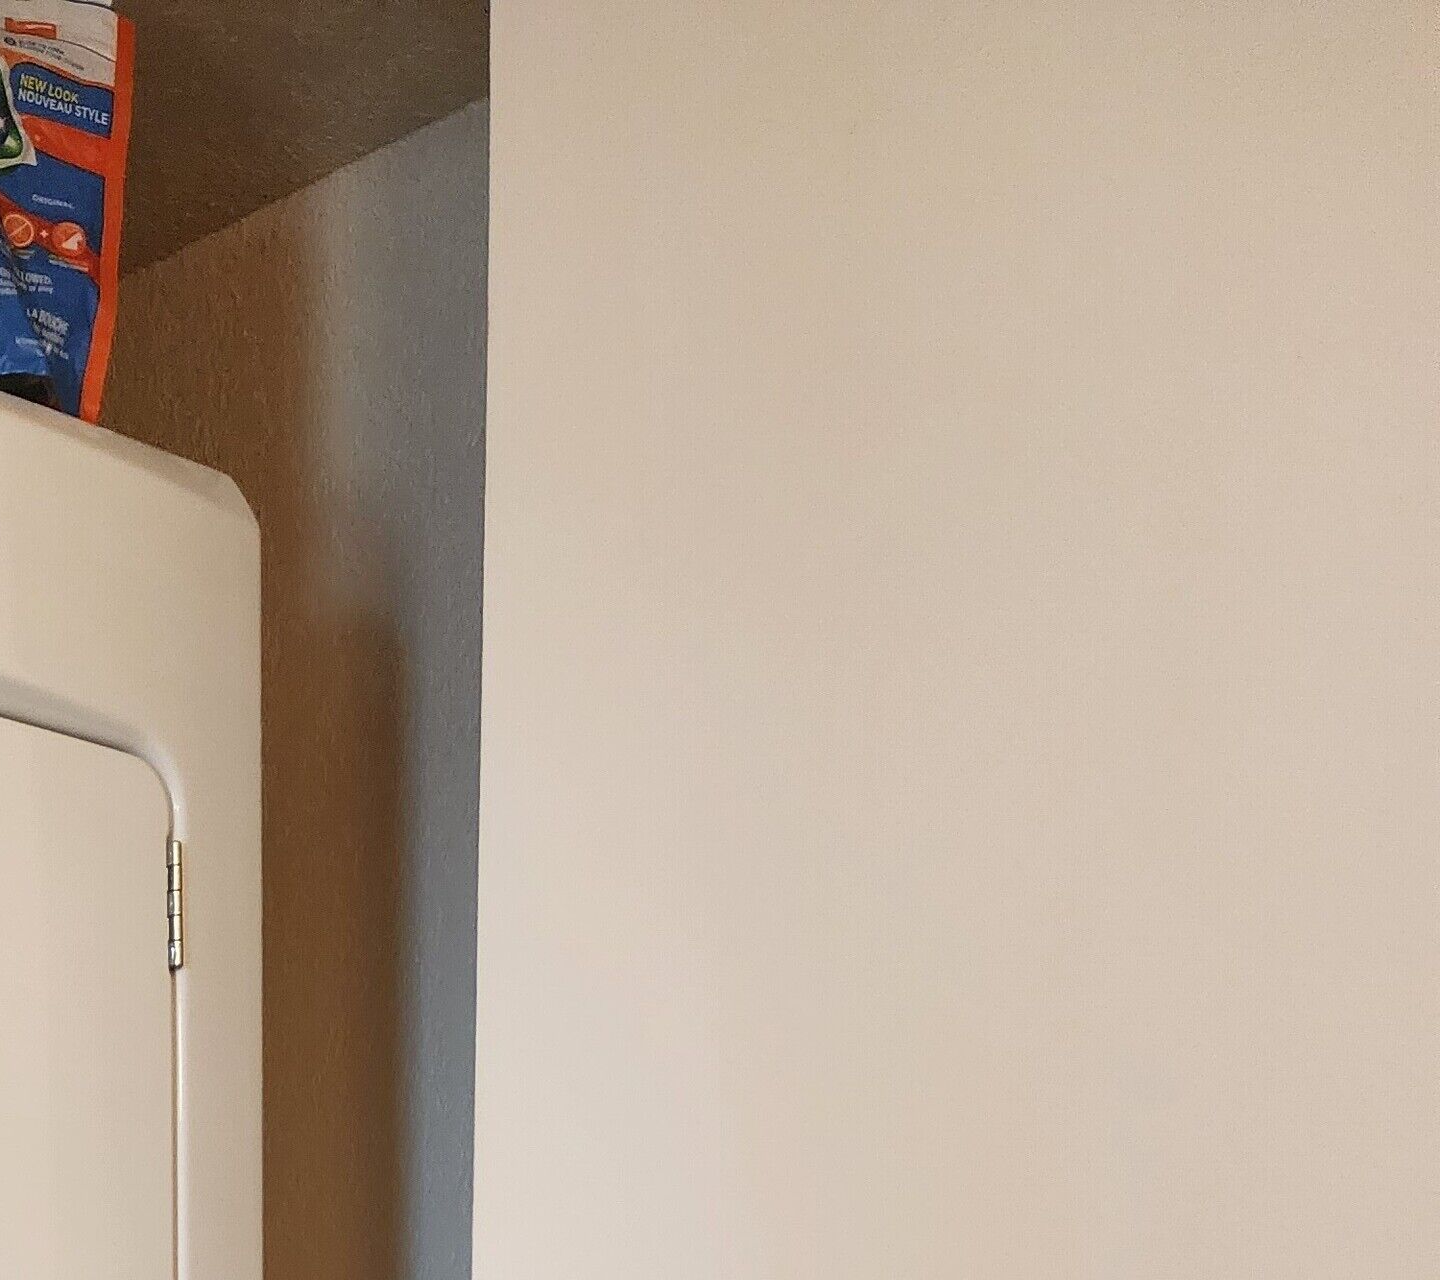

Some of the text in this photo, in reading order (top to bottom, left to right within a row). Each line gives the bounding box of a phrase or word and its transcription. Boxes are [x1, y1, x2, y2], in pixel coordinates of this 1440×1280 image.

[20, 73, 79, 104] NEW LOOK
[18, 90, 109, 126] NOUVEAU STYLE
